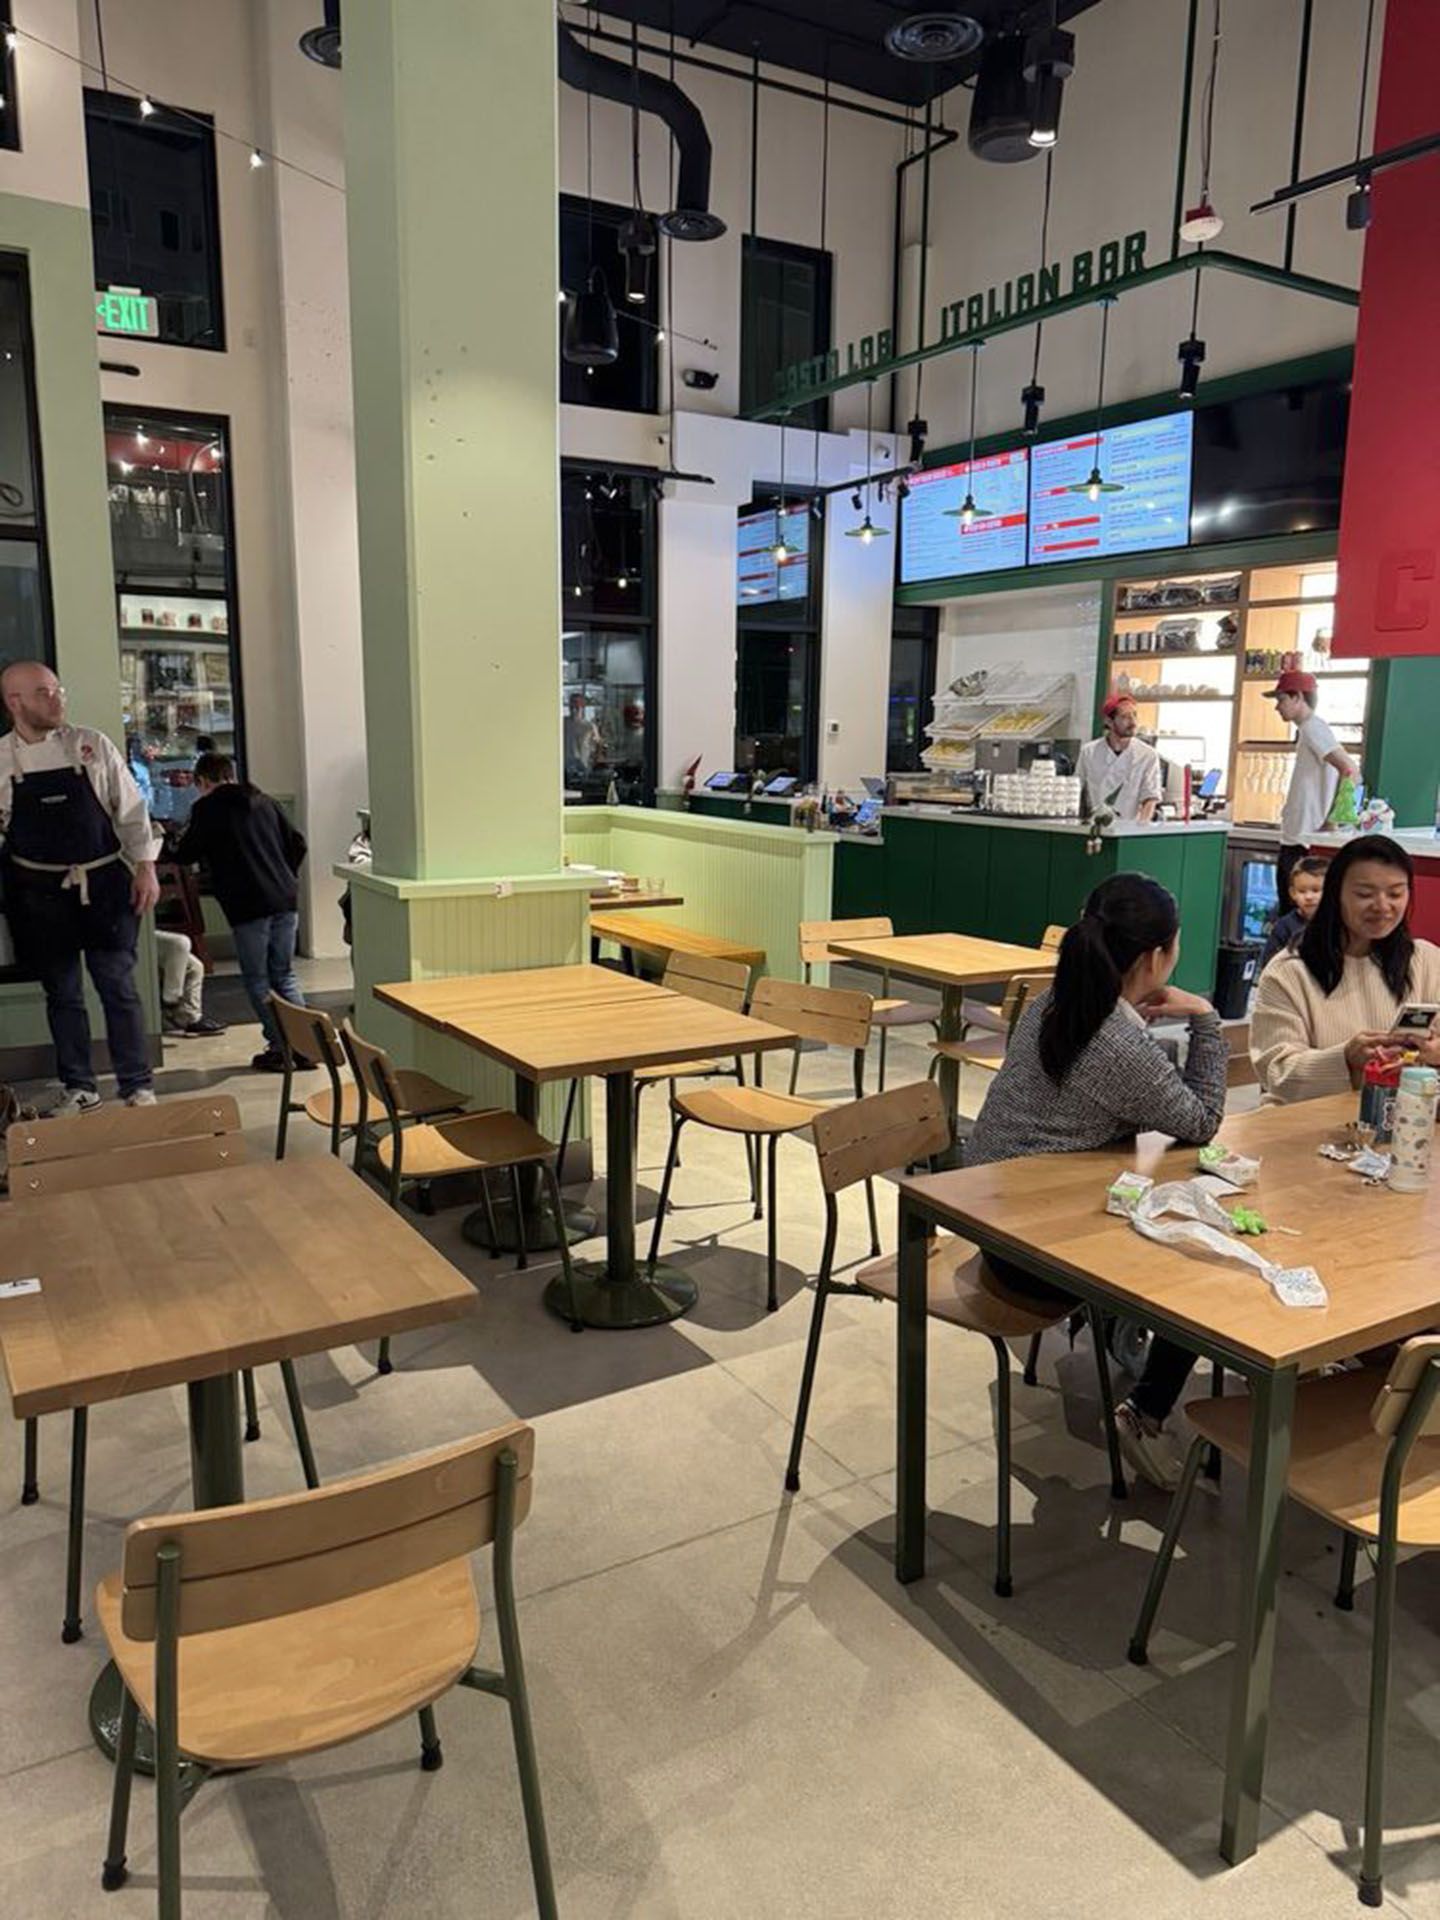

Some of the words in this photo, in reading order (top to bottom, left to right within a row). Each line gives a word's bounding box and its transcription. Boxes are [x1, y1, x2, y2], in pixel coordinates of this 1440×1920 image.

[940, 263, 1060, 341] ITALIAN
[1072, 231, 1146, 293] BAR
[105, 294, 149, 331] EXIT
[848, 329, 892, 373] LAB
